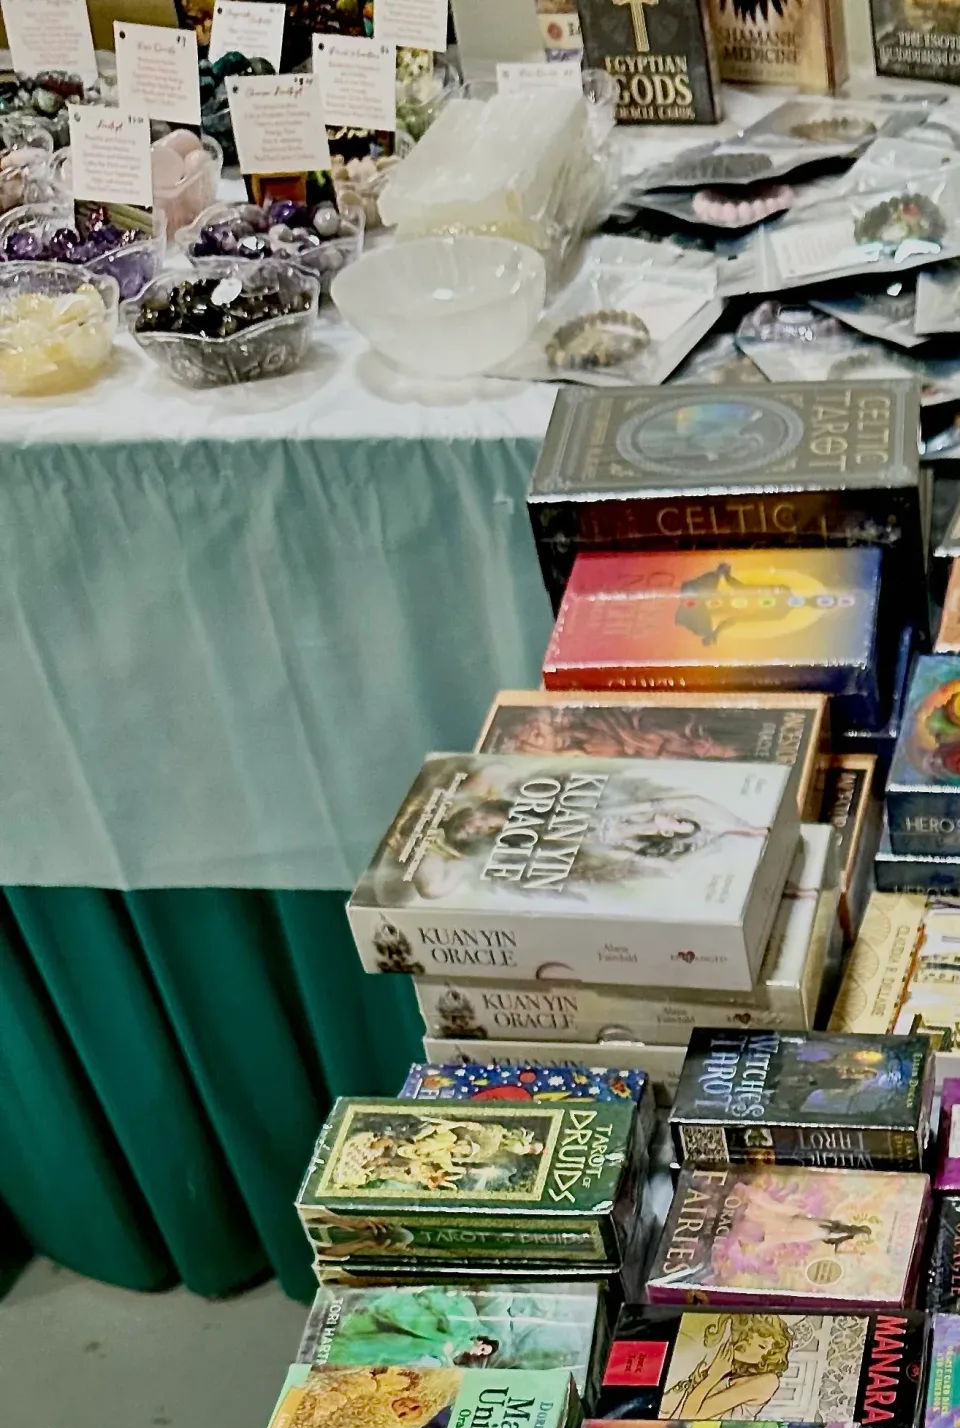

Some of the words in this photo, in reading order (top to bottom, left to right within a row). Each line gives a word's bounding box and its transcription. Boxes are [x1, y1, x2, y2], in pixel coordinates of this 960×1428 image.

[811, 391, 852, 472] TAROT
[856, 389, 892, 466] CELTIC
[656, 501, 798, 537] CELTIC
[480, 777, 562, 882] ORACLE
[418, 927, 480, 948] KUAN
[479, 929, 517, 948] YIN
[430, 947, 518, 968] ORACLE
[483, 993, 543, 1013] KUAN
[542, 995, 579, 1014] YIN
[494, 1012, 576, 1032] ORACLE
[696, 1036, 747, 1113] TAROT
[731, 1033, 782, 1118] WITCHES
[548, 1110, 597, 1203] DRUIDS
[593, 1123, 612, 1178] TAROT
[663, 1169, 730, 1275] FAIRIES
[862, 1314, 908, 1424] MANARA
